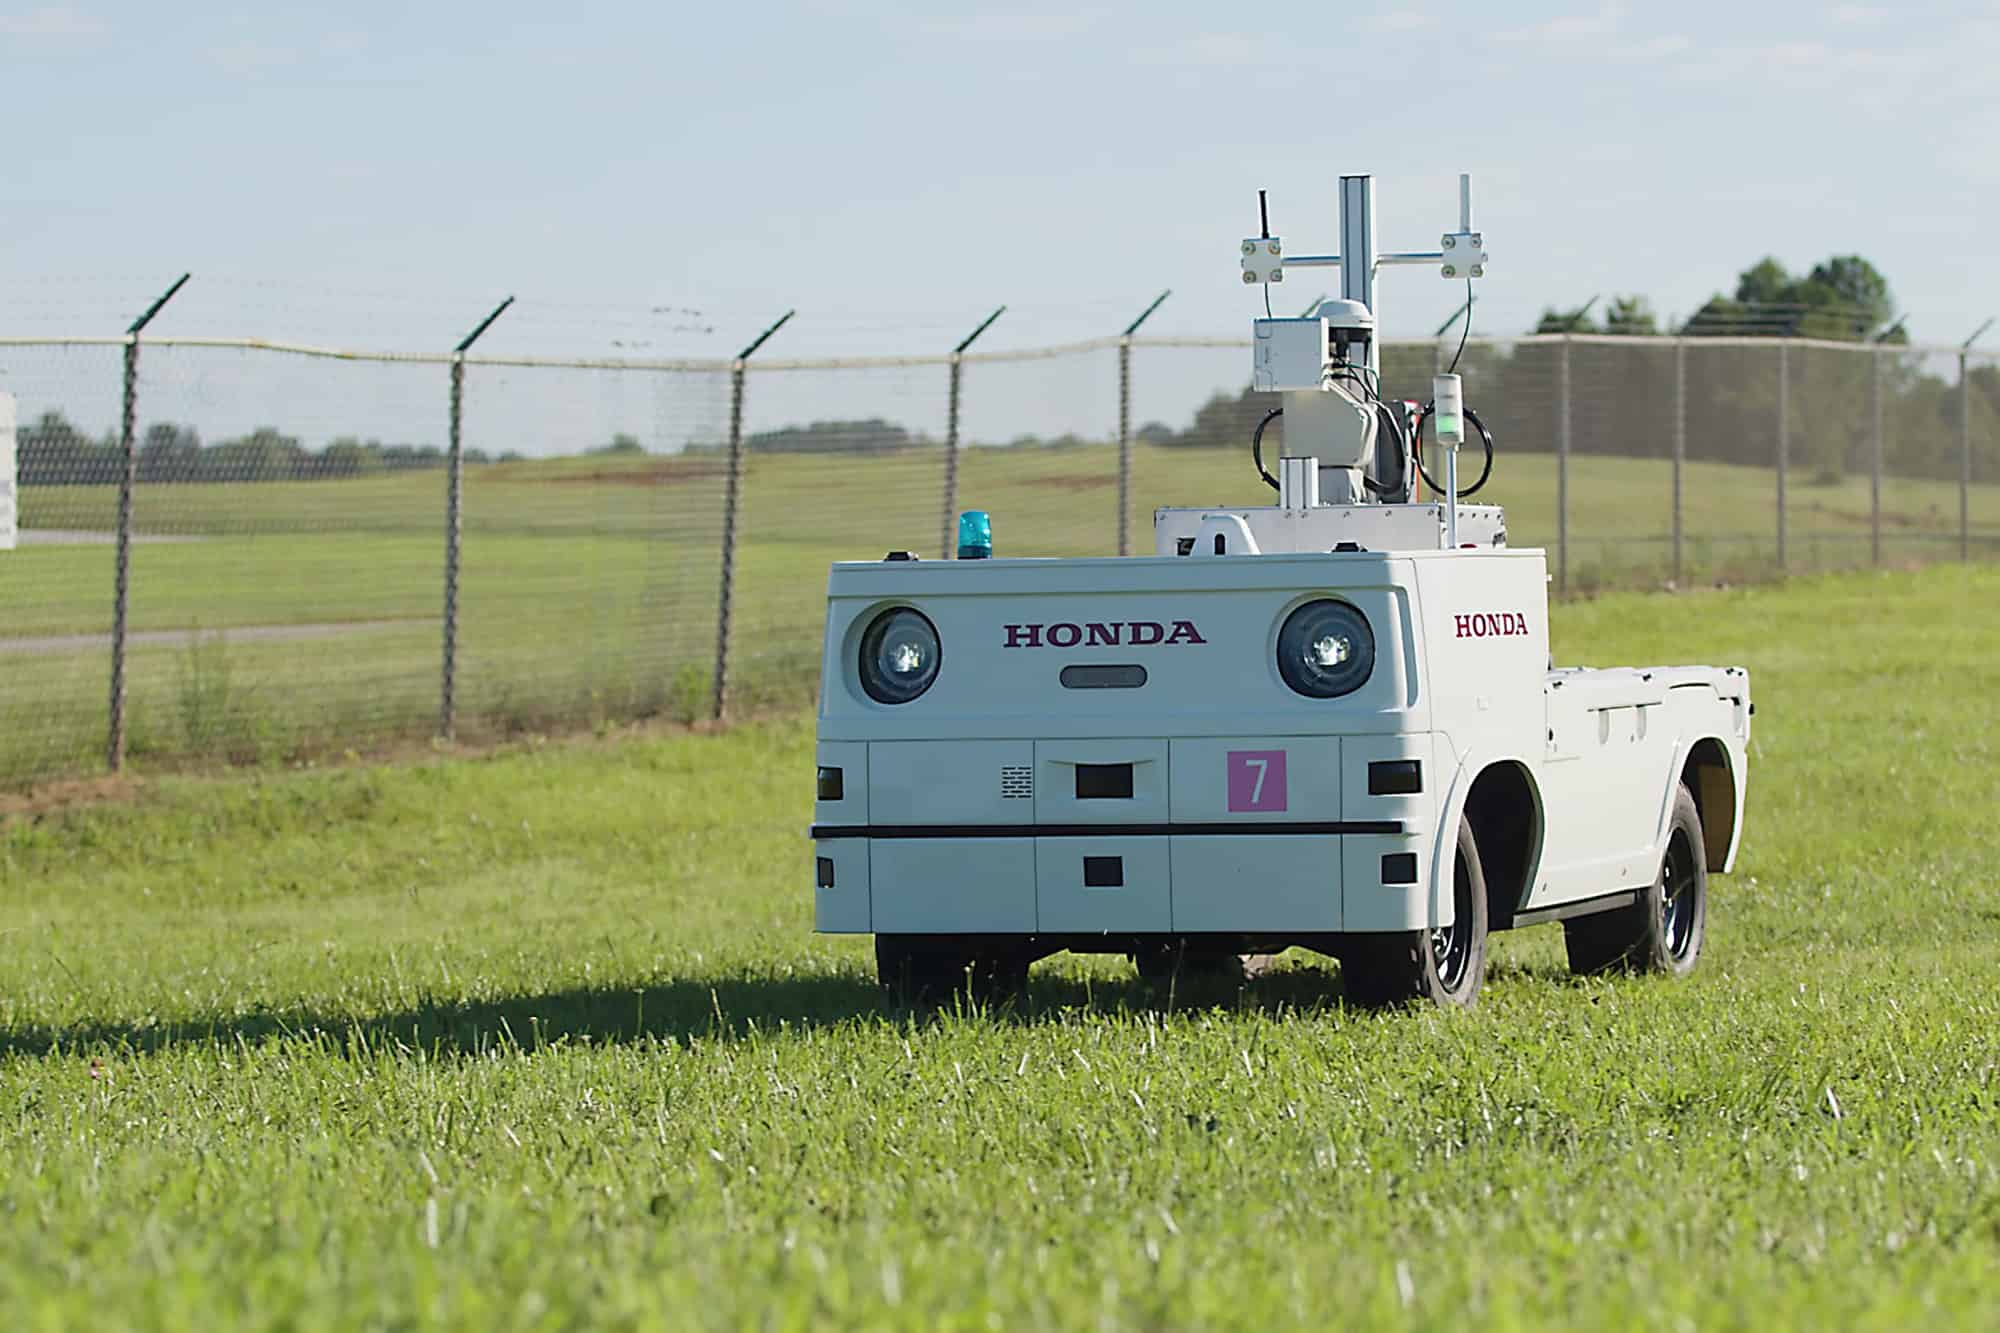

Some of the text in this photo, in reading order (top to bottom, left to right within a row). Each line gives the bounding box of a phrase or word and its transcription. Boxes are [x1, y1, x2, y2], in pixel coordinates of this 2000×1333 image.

[1003, 621, 1208, 649] HONDA
[1454, 612, 1529, 638] HONDA
[1246, 759, 1267, 804] 7
